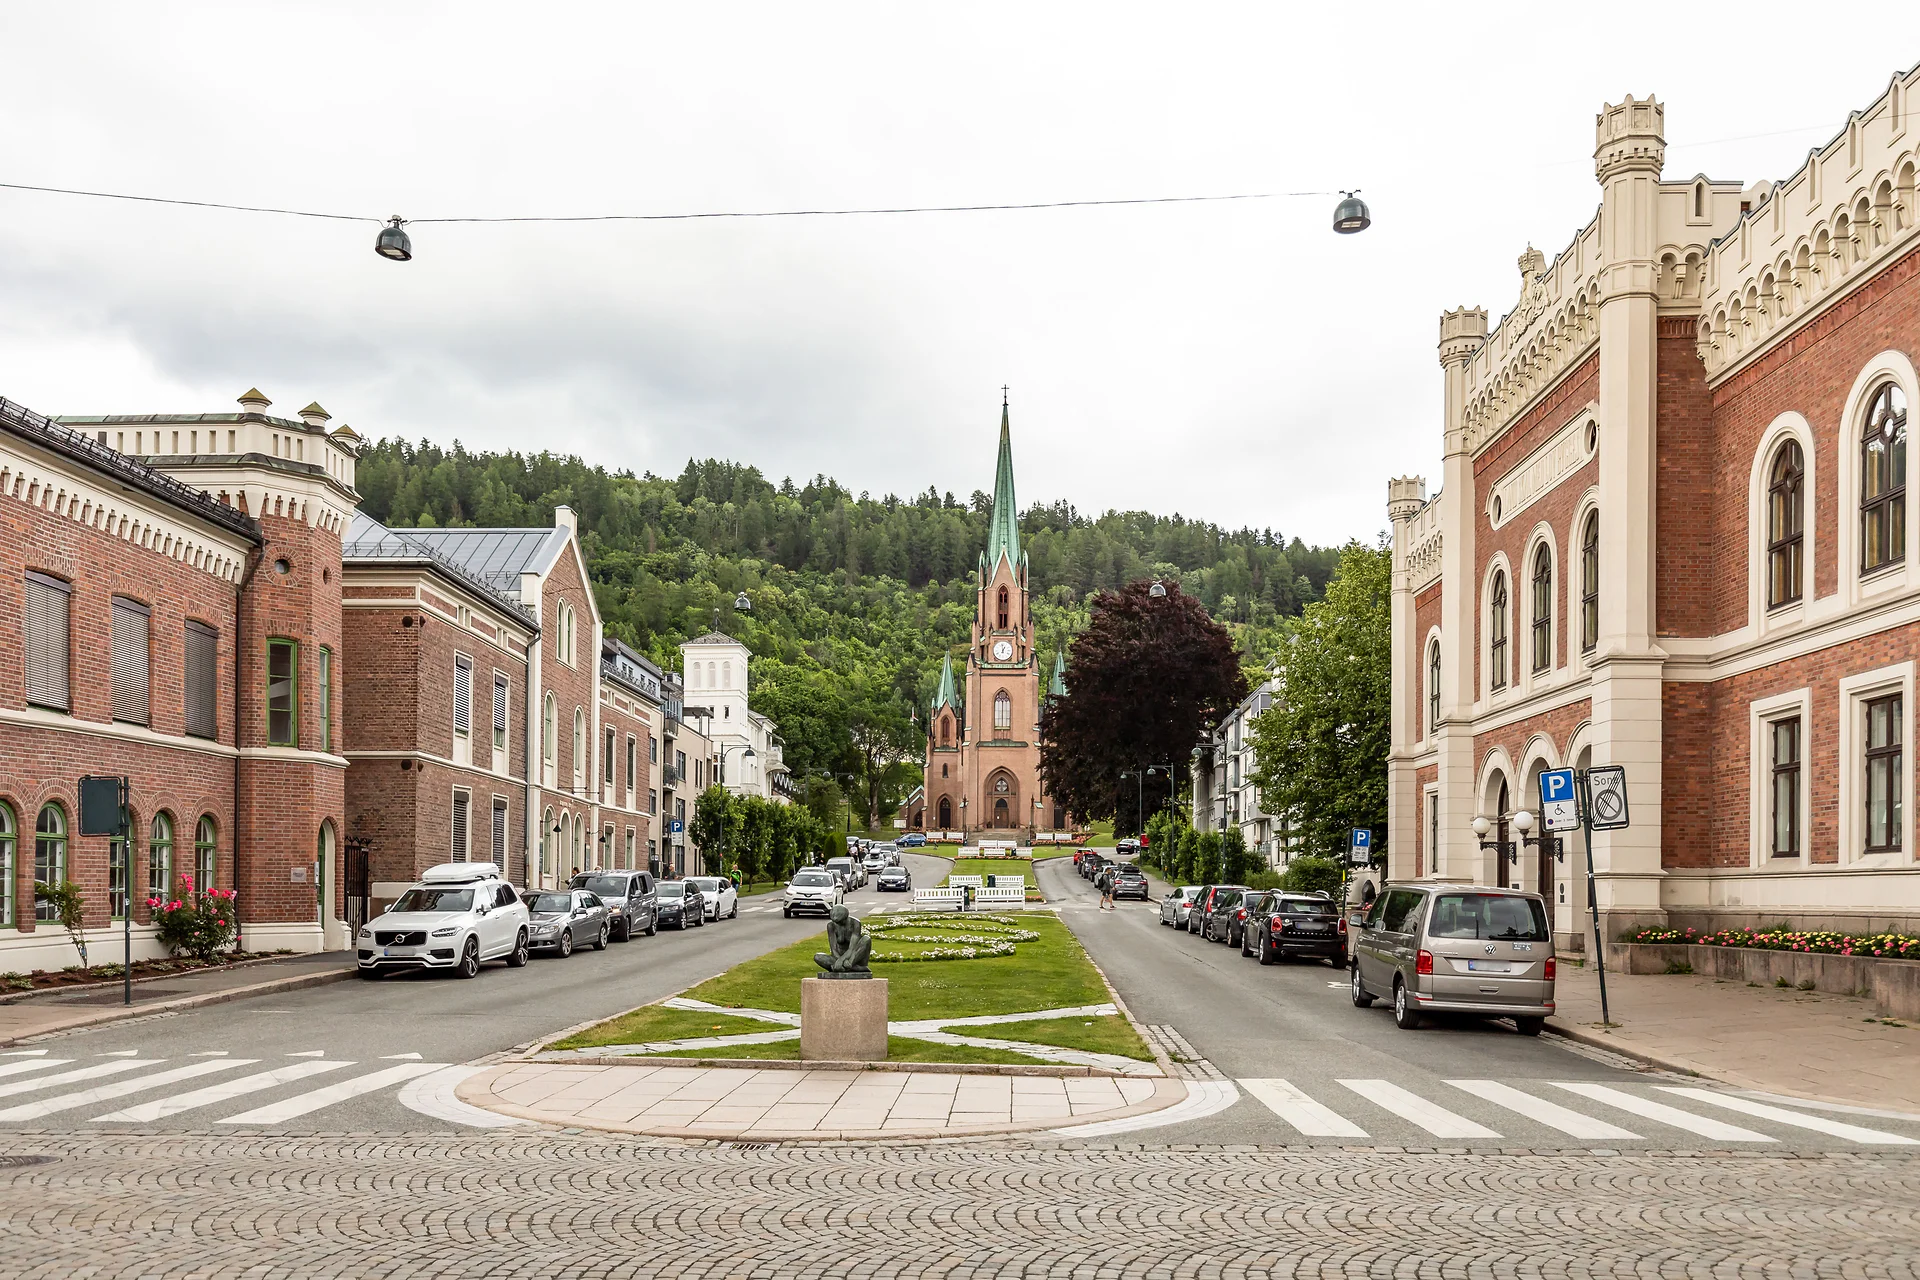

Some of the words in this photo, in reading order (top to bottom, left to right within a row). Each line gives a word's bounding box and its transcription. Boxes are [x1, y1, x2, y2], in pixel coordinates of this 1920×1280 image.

[1548, 775, 1565, 798] P
[674, 822, 680, 832] P
[1356, 832, 1366, 844] P
